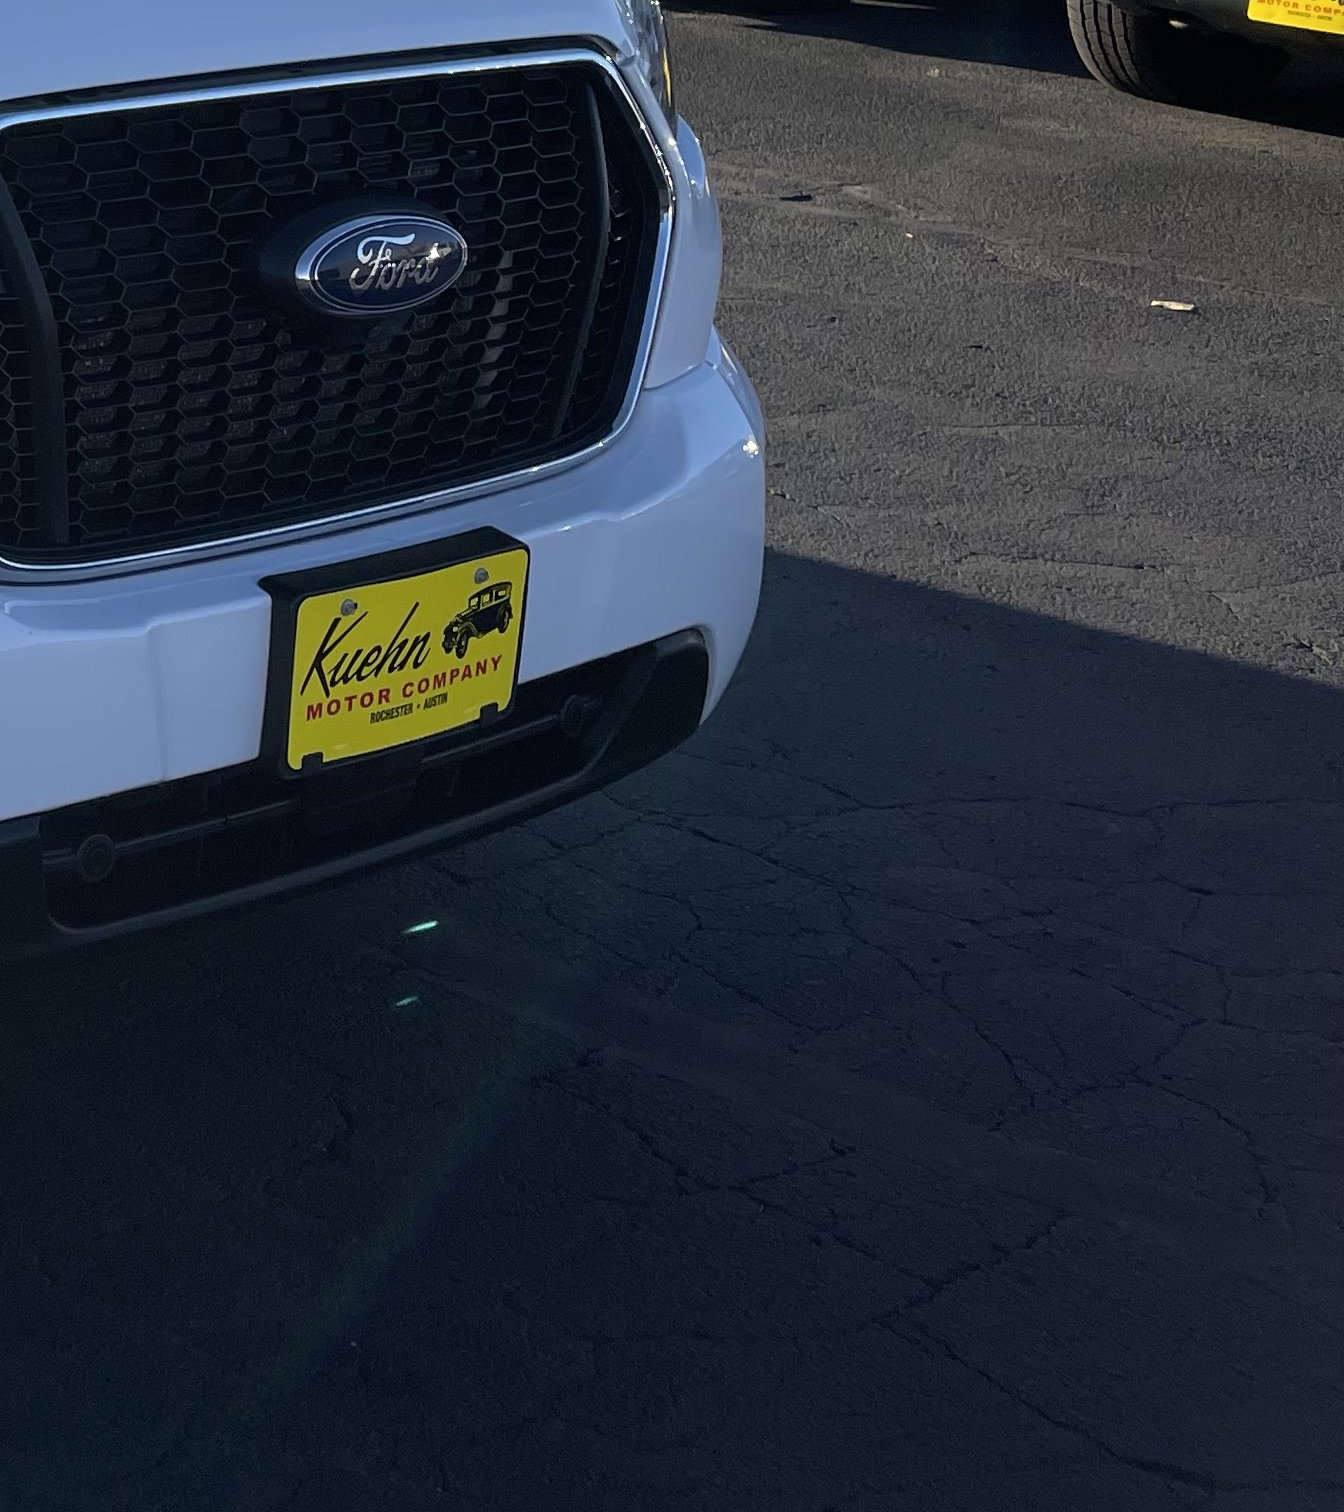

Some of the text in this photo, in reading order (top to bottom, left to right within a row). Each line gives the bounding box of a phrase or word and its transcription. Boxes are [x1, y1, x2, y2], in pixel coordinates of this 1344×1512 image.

[348, 233, 440, 290] Ford
[299, 601, 432, 698] Kuehn
[306, 655, 503, 721] MOTOR COMPANY
[369, 691, 449, 724] ROCHESTER AUSTIN
